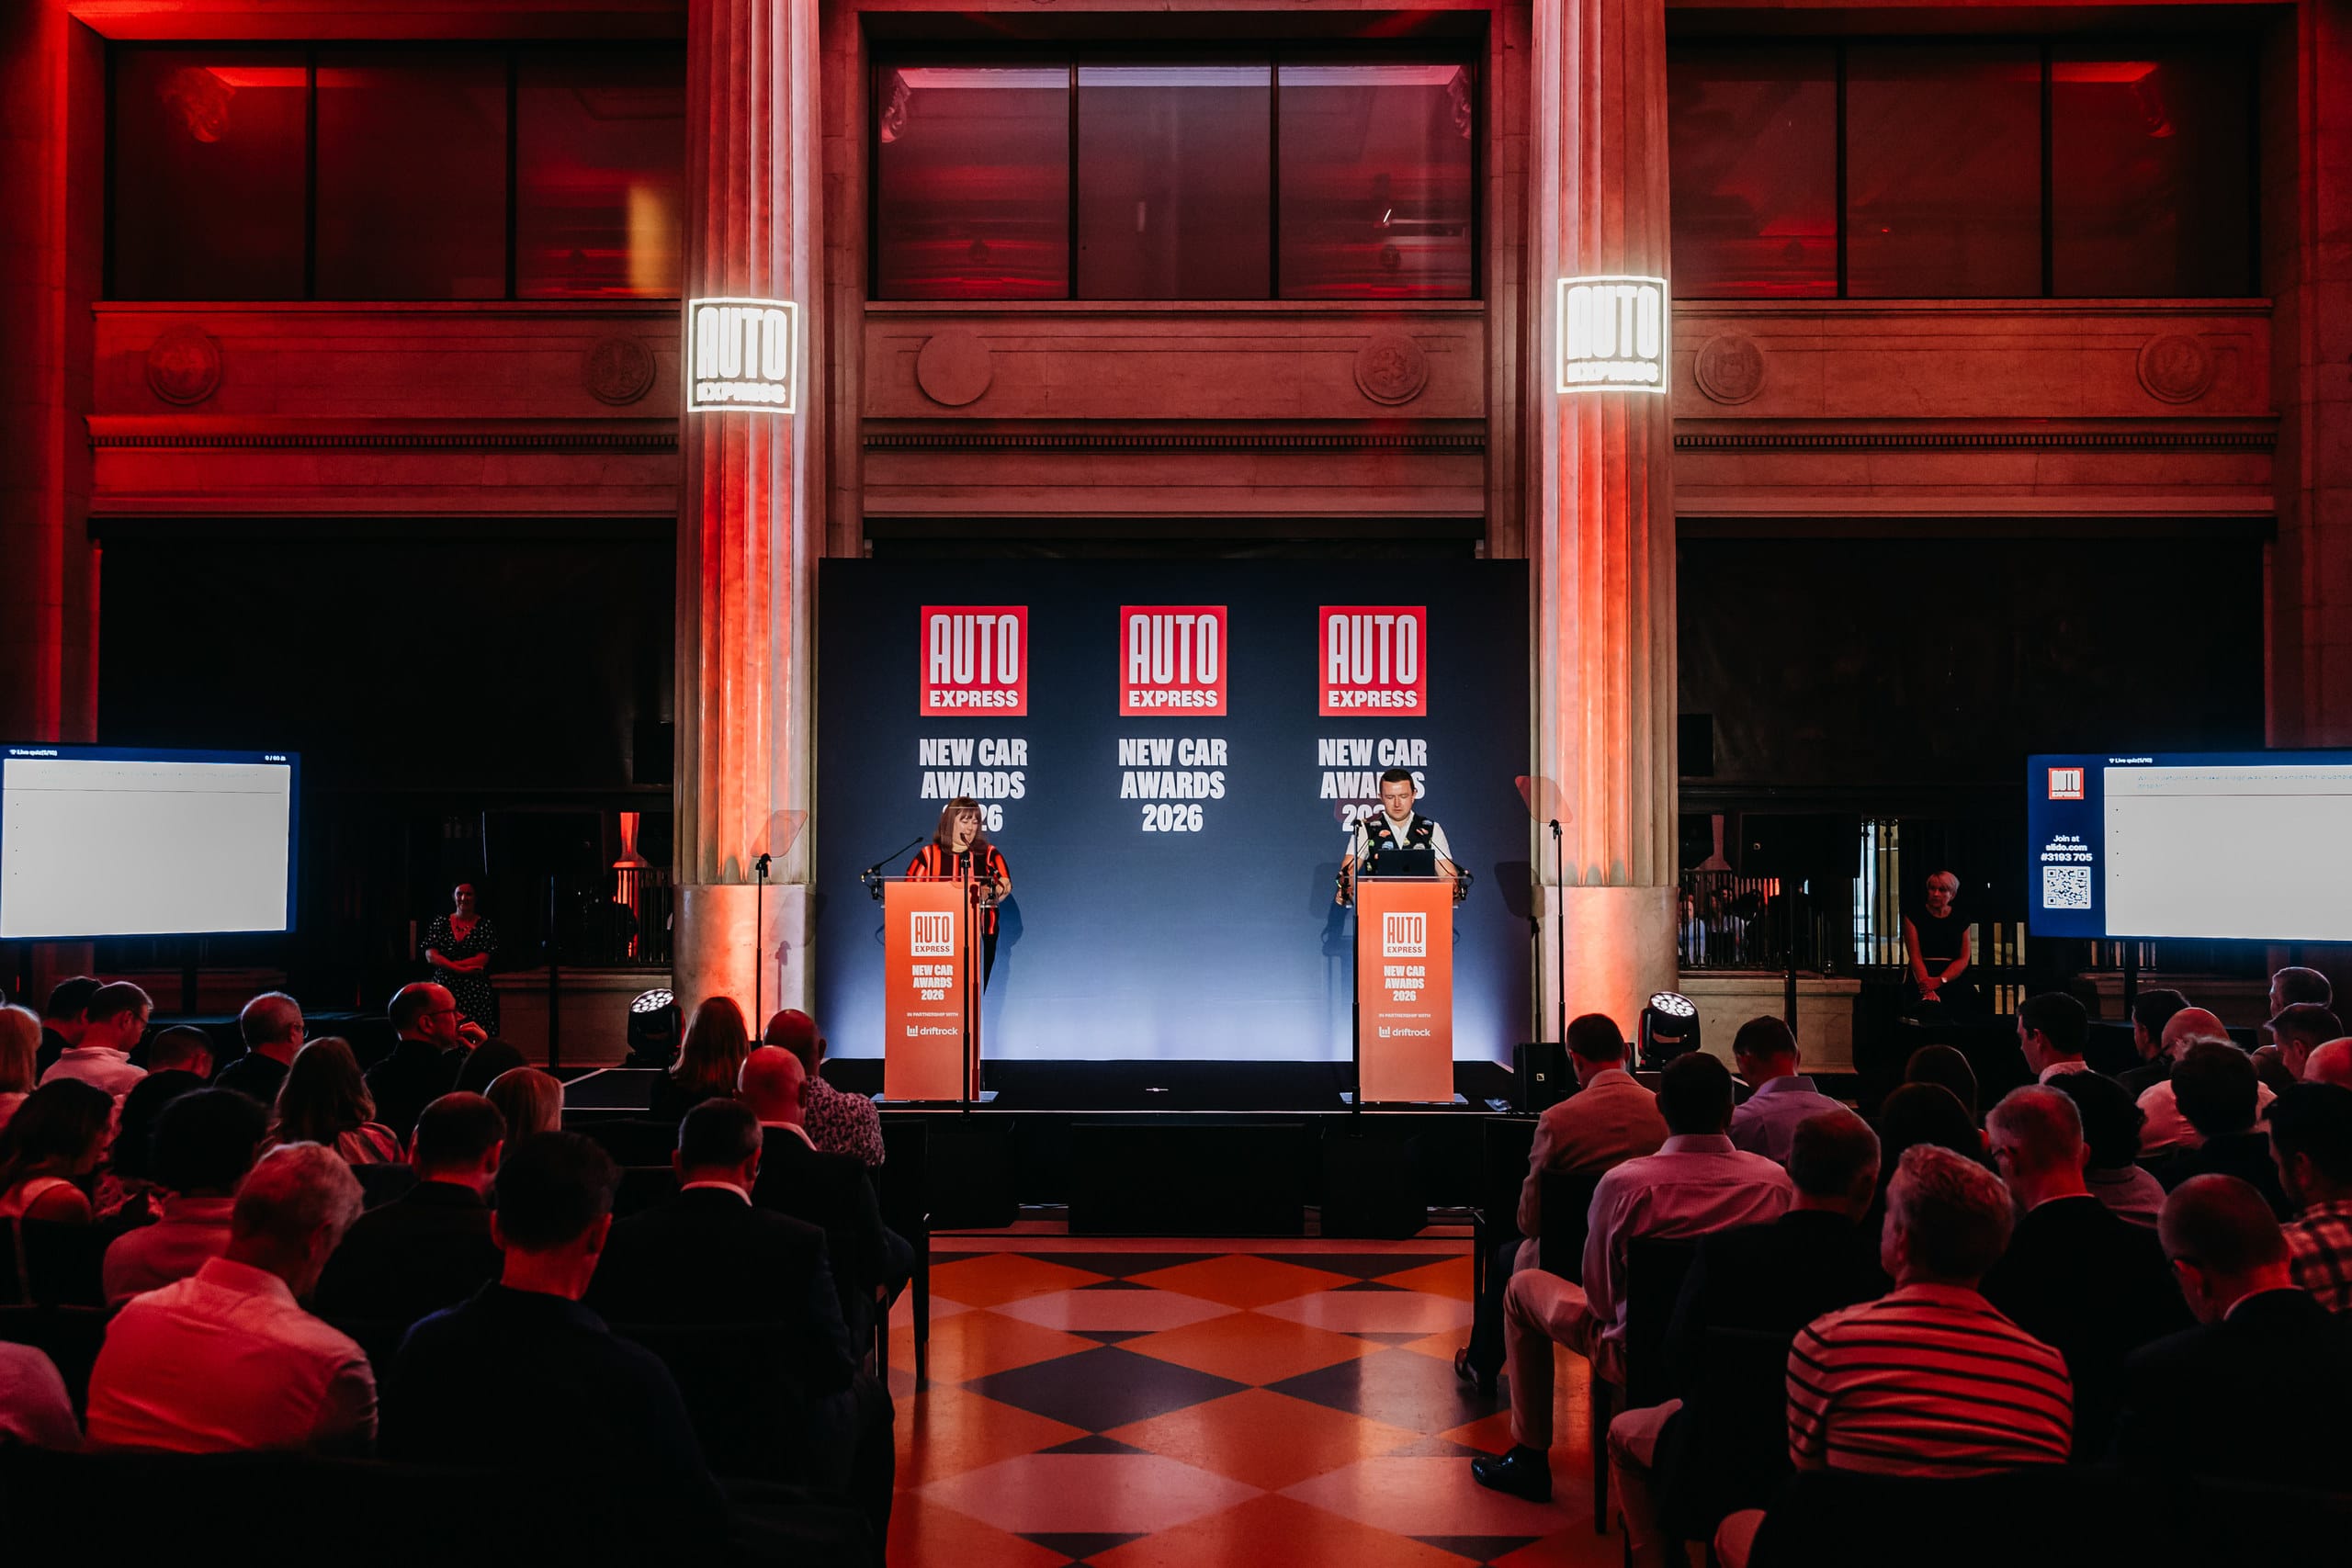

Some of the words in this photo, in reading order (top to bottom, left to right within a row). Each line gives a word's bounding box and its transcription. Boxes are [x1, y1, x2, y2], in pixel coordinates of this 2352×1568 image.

[1566, 286, 1659, 359] AUTO
[696, 307, 787, 380] AUTO
[696, 382, 786, 404] EXPRESS
[929, 615, 1018, 684] AUTO
[1129, 615, 1218, 684] AUTO
[1328, 615, 1417, 684] AUTO
[929, 690, 1018, 707] EXPRESS
[1129, 690, 1218, 707] EXPRESS
[1328, 690, 1417, 707] EXPRESS
[919, 739, 974, 766] NEW
[978, 738, 1028, 767] CAR
[1119, 739, 1174, 766] NEW
[1178, 738, 1227, 767] CAR
[1318, 739, 1374, 766] NEW
[1378, 738, 1427, 767] CAR
[921, 771, 1025, 799] AWARDS
[1120, 771, 1226, 799] AWARDS
[1320, 771, 1425, 799] AWAS
[1142, 804, 1204, 832] 2026
[2041, 853, 2072, 861] #3193
[2073, 853, 2093, 861] 705
[915, 916, 950, 943] AUTO
[1387, 917, 1422, 944] AUTO
[911, 964, 933, 976] NEW
[934, 964, 953, 976] CAR
[913, 977, 952, 988] AWARDS
[1383, 965, 1405, 977] NEW
[1406, 965, 1425, 977] CAR
[1385, 978, 1425, 989] AWARDS
[921, 989, 944, 1000] 2026
[1393, 990, 1416, 1001] 2026
[920, 1027, 958, 1035] driftrock
[1392, 1028, 1431, 1036] driftrock
